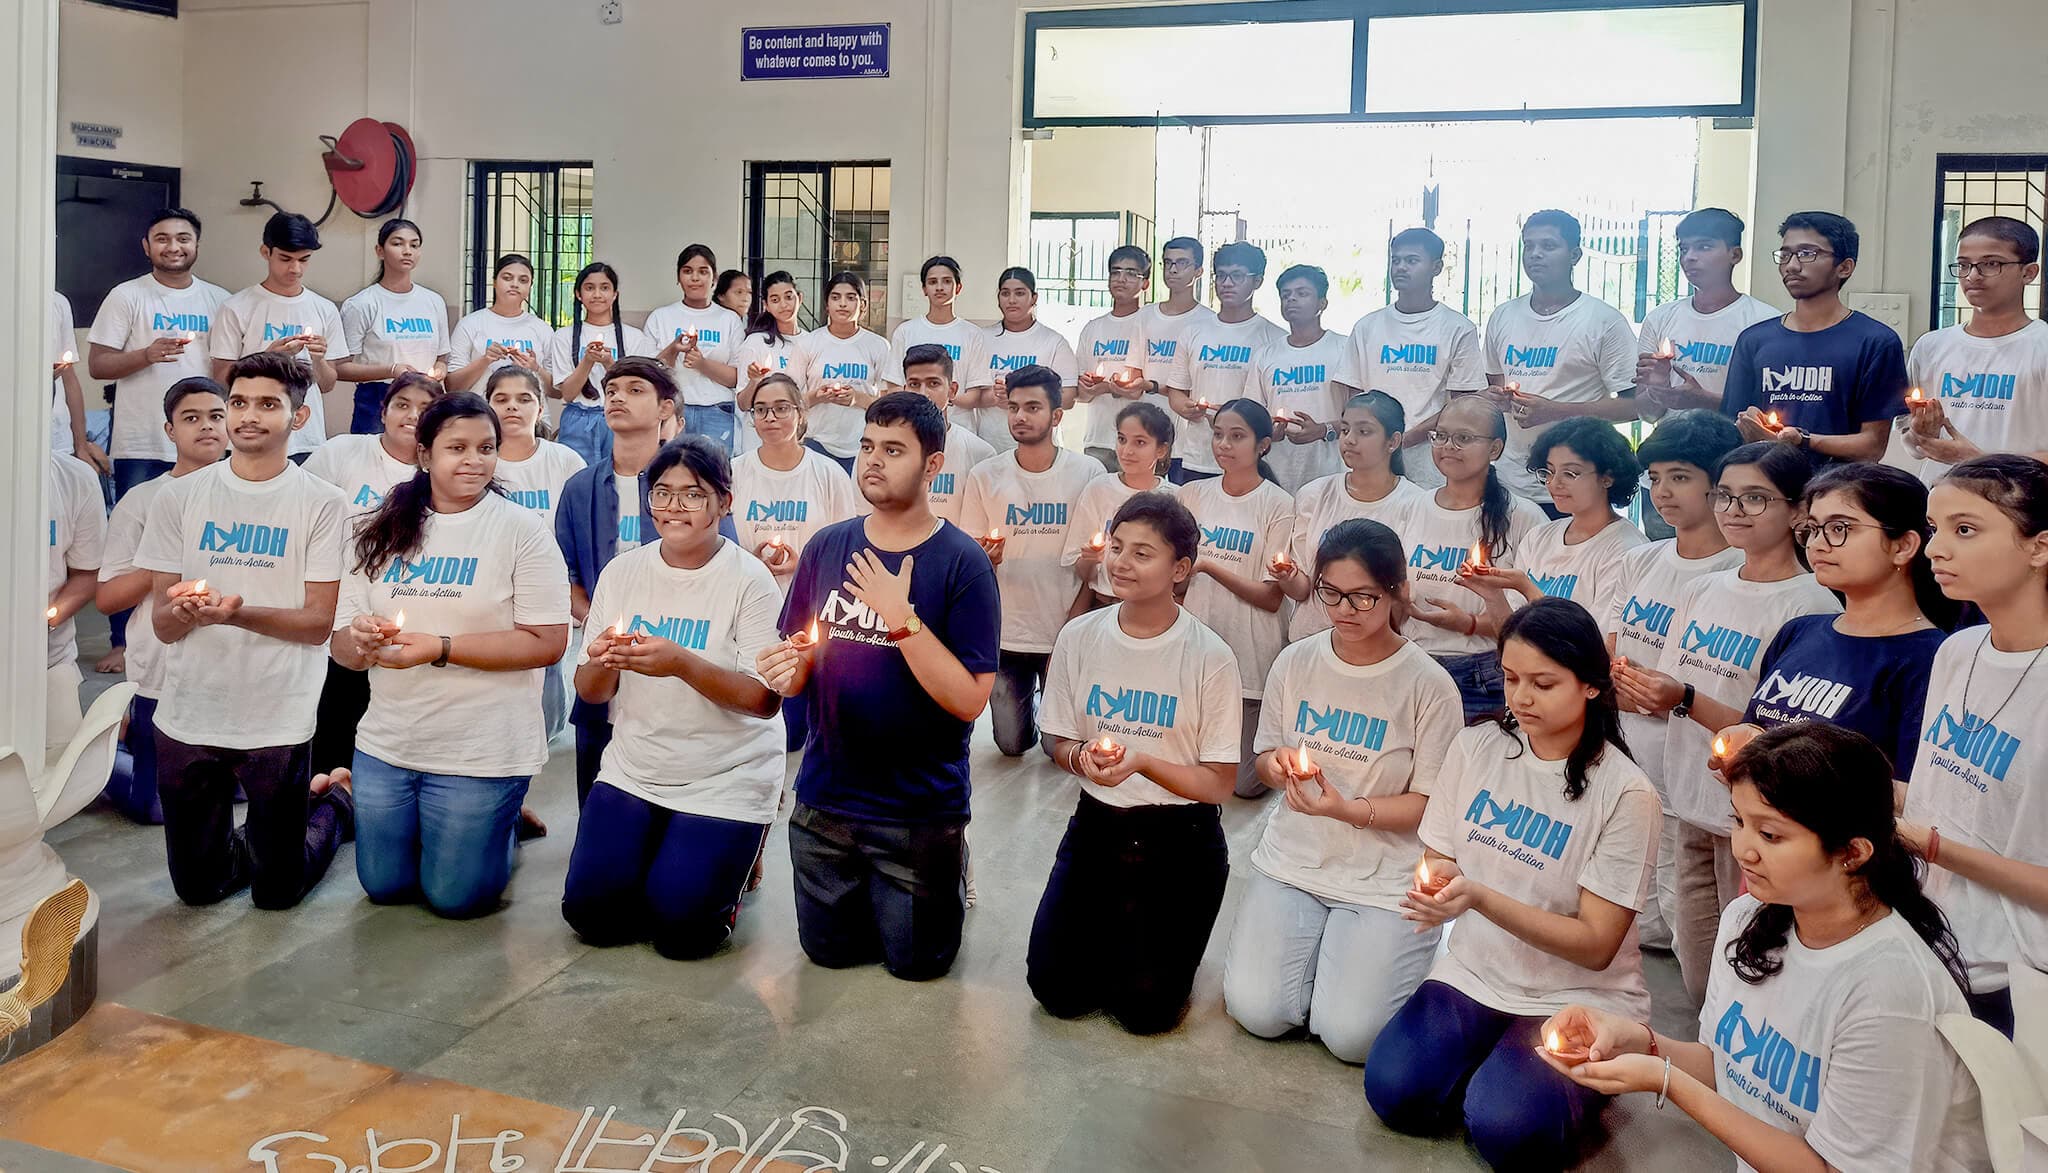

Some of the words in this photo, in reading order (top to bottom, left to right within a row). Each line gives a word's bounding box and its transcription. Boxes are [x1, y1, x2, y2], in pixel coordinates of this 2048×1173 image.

[749, 35, 762, 50] Be
[765, 34, 803, 49] content
[805, 33, 824, 48] and
[826, 32, 858, 51] happy
[860, 31, 882, 46] with
[755, 54, 800, 69] whatever
[803, 55, 836, 67] comes
[838, 52, 850, 66] to
[851, 53, 874, 69] you.
[391, 587, 417, 599] Youth
[429, 587, 463, 598] Action
[828, 626, 855, 640] Youth
[1097, 720, 1120, 733] Youth
[1132, 726, 1163, 739] Action
[1334, 747, 1369, 762] Action
[1467, 829, 1497, 847] Youth
[1497, 841, 1508, 853] in
[1508, 847, 1544, 871] Action
